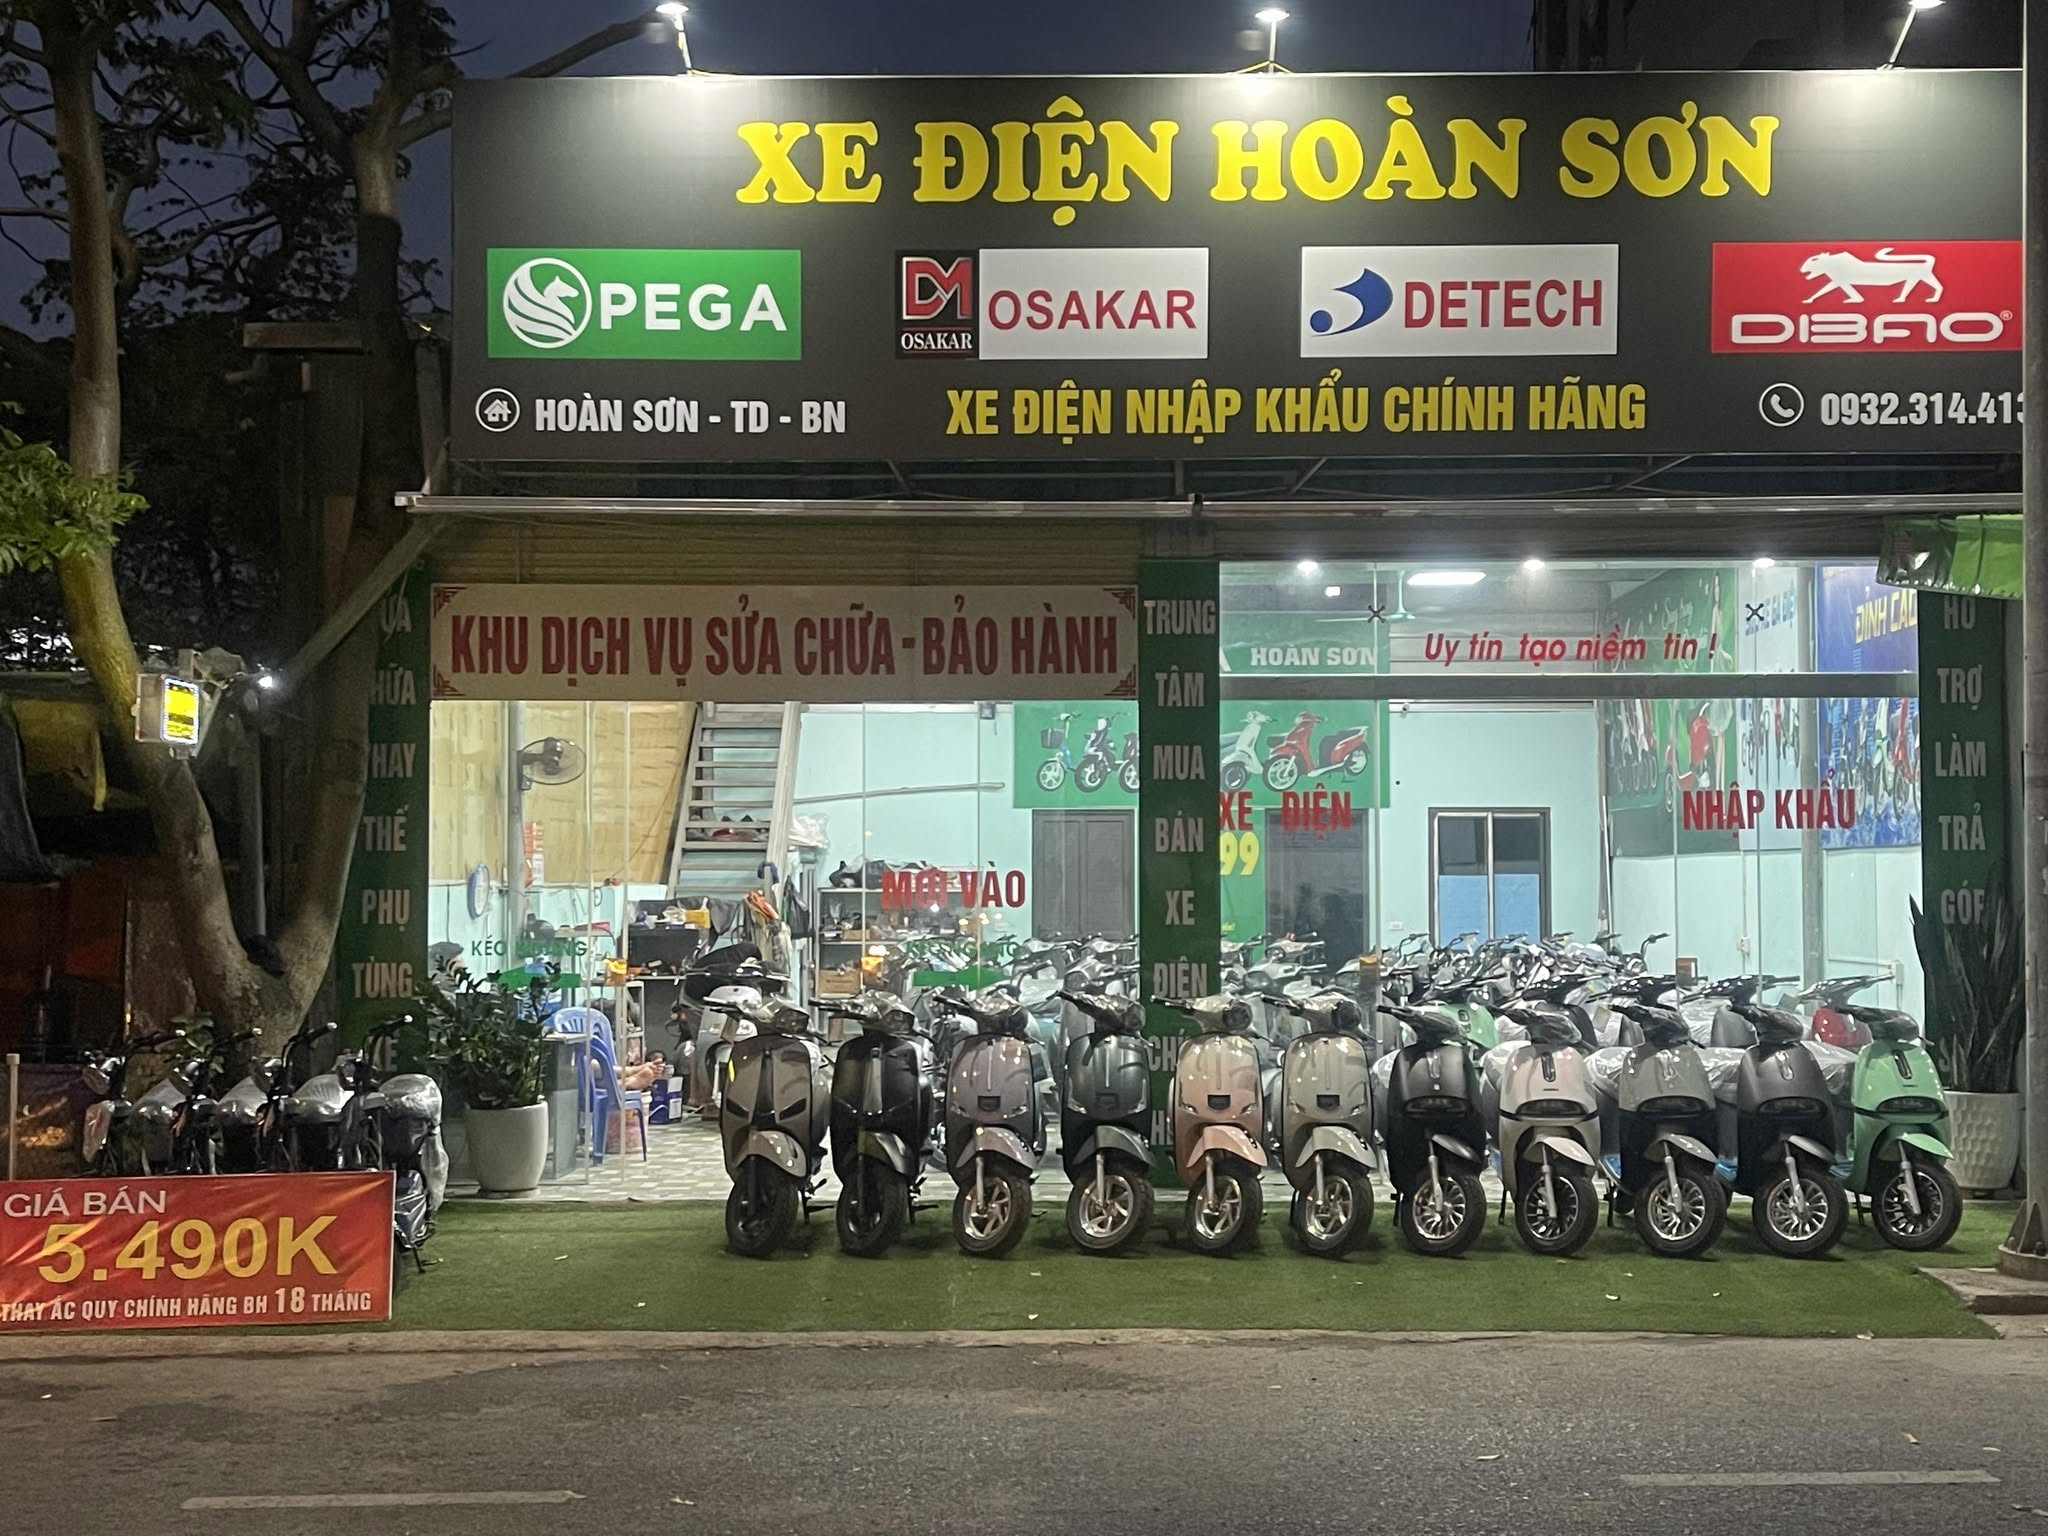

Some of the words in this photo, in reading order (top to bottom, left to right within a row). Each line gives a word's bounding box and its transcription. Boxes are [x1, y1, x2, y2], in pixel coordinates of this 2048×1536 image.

[736, 120, 883, 204] XE
[913, 95, 1179, 227] ĐIỆN
[1210, 94, 1527, 202] HOÀN
[1559, 100, 1781, 199] SƠN
[600, 282, 788, 331] PEGA
[988, 289, 1198, 331] OSAKAR
[1404, 278, 1603, 329] DETECH
[901, 333, 973, 350] OSAKAR
[535, 394, 623, 434] HOÀN
[632, 396, 699, 434] SƠN
[731, 401, 770, 433] TD
[802, 401, 847, 433] BN
[945, 388, 999, 435] XE
[1012, 380, 1111, 444] ĐIỆN
[1126, 380, 1244, 444] NHẬP
[1255, 368, 1370, 433] KHẨU
[1382, 376, 1515, 431] CHÍNH
[1529, 376, 1646, 430] HÃNG
[451, 615, 529, 676] KHU
[541, 615, 630, 687] DỊCH
[643, 615, 693, 687] VỤ
[705, 593, 783, 676] SỬA
[794, 602, 896, 676] CHỮA
[922, 593, 998, 677] BẢO
[1011, 600, 1118, 676] HÀNH
[1143, 600, 1216, 635] TRUNG
[1250, 643, 1320, 666] HOÀN
[1326, 646, 1376, 666] SƠN
[1424, 632, 1461, 667] Uy
[1468, 631, 1503, 661] tín
[1519, 632, 1567, 667] tạo
[1575, 623, 1646, 661] niềm
[1663, 631, 1698, 661] tin
[1155, 665, 1205, 708] TÂM
[1936, 664, 1983, 711] TRỢ
[1152, 744, 1206, 781] MUA
[1935, 733, 1987, 778] LÀM
[1219, 791, 1254, 831] XE
[1281, 782, 1352, 840] ĐIỆN
[1682, 780, 1765, 839] NHẬP
[1774, 767, 1857, 829] KHẨU
[363, 804, 410, 852] THẾ
[1154, 808, 1205, 853] BÁN
[1938, 804, 1986, 852] TRẢ
[880, 860, 948, 909] MỜI
[959, 860, 1026, 908] VÀO
[361, 888, 411, 932] PHỤ
[1164, 890, 1196, 927] XE
[3, 1187, 70, 1217] GIÁ
[82, 1184, 167, 1215] BÁN
[38, 1214, 340, 1284] 5.490K
[124, 1294, 182, 1318] CHÍNH
[243, 1295, 268, 1315] BH
[275, 1286, 306, 1313] 18
[312, 1290, 372, 1313] THÁNG
